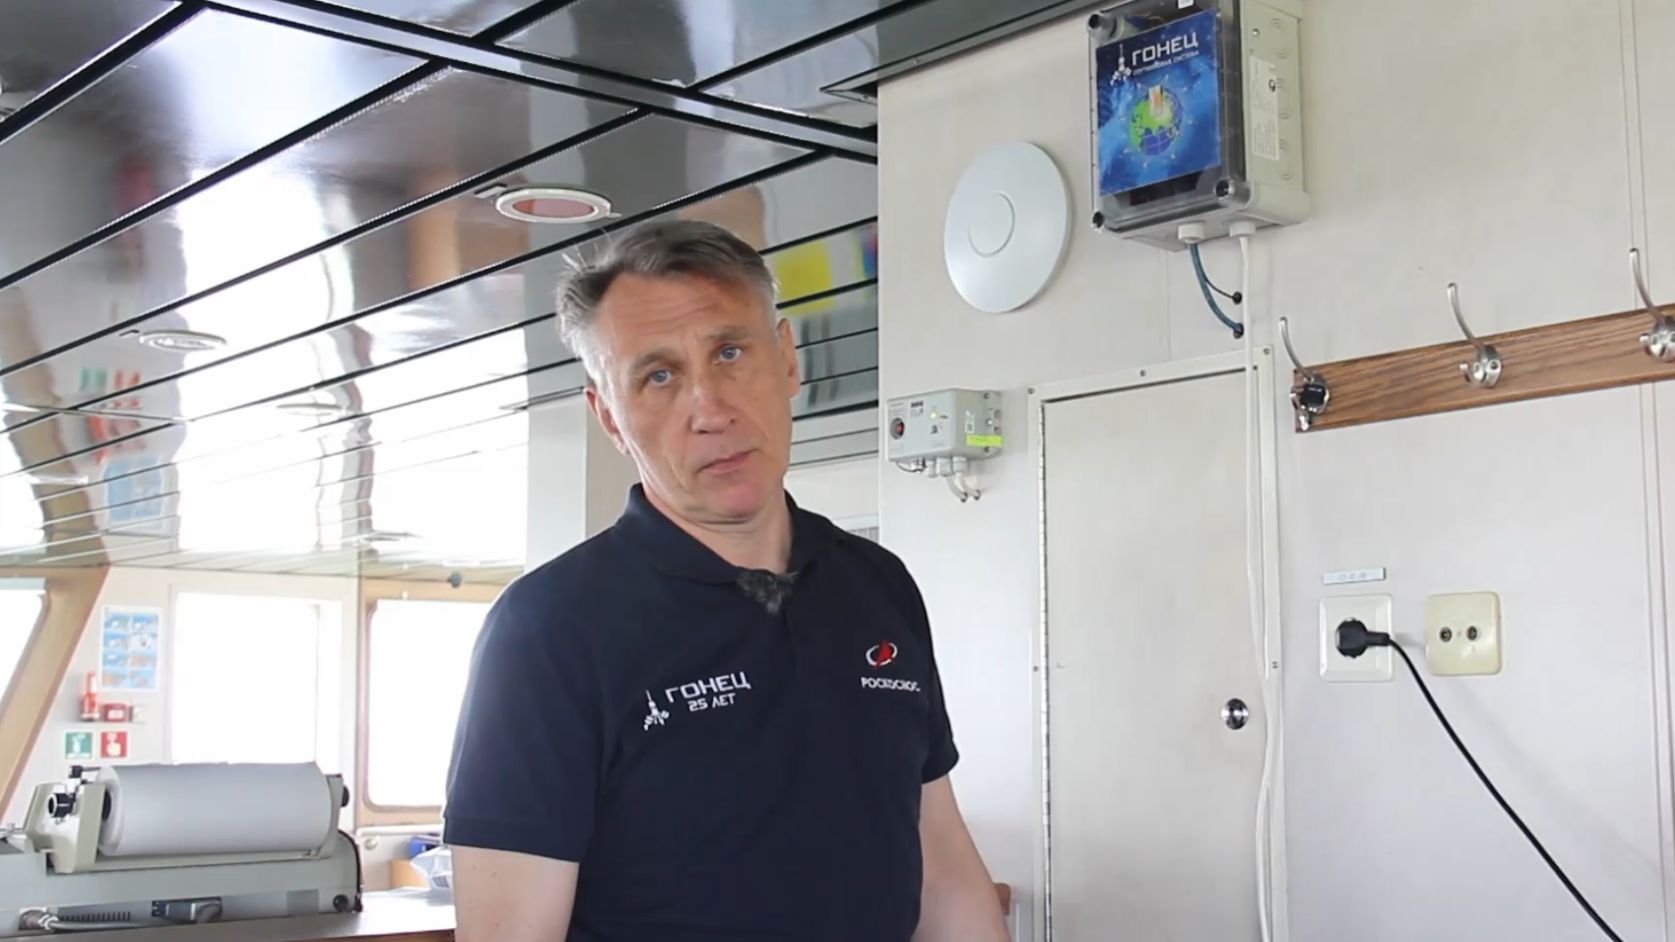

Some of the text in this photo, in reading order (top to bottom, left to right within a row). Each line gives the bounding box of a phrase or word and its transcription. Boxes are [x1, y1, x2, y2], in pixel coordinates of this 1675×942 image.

[1132, 32, 1199, 66] ГОНЕЦ
[665, 671, 752, 703] ГОНЕЦ
[688, 692, 736, 712] 25 ЛЕТ
